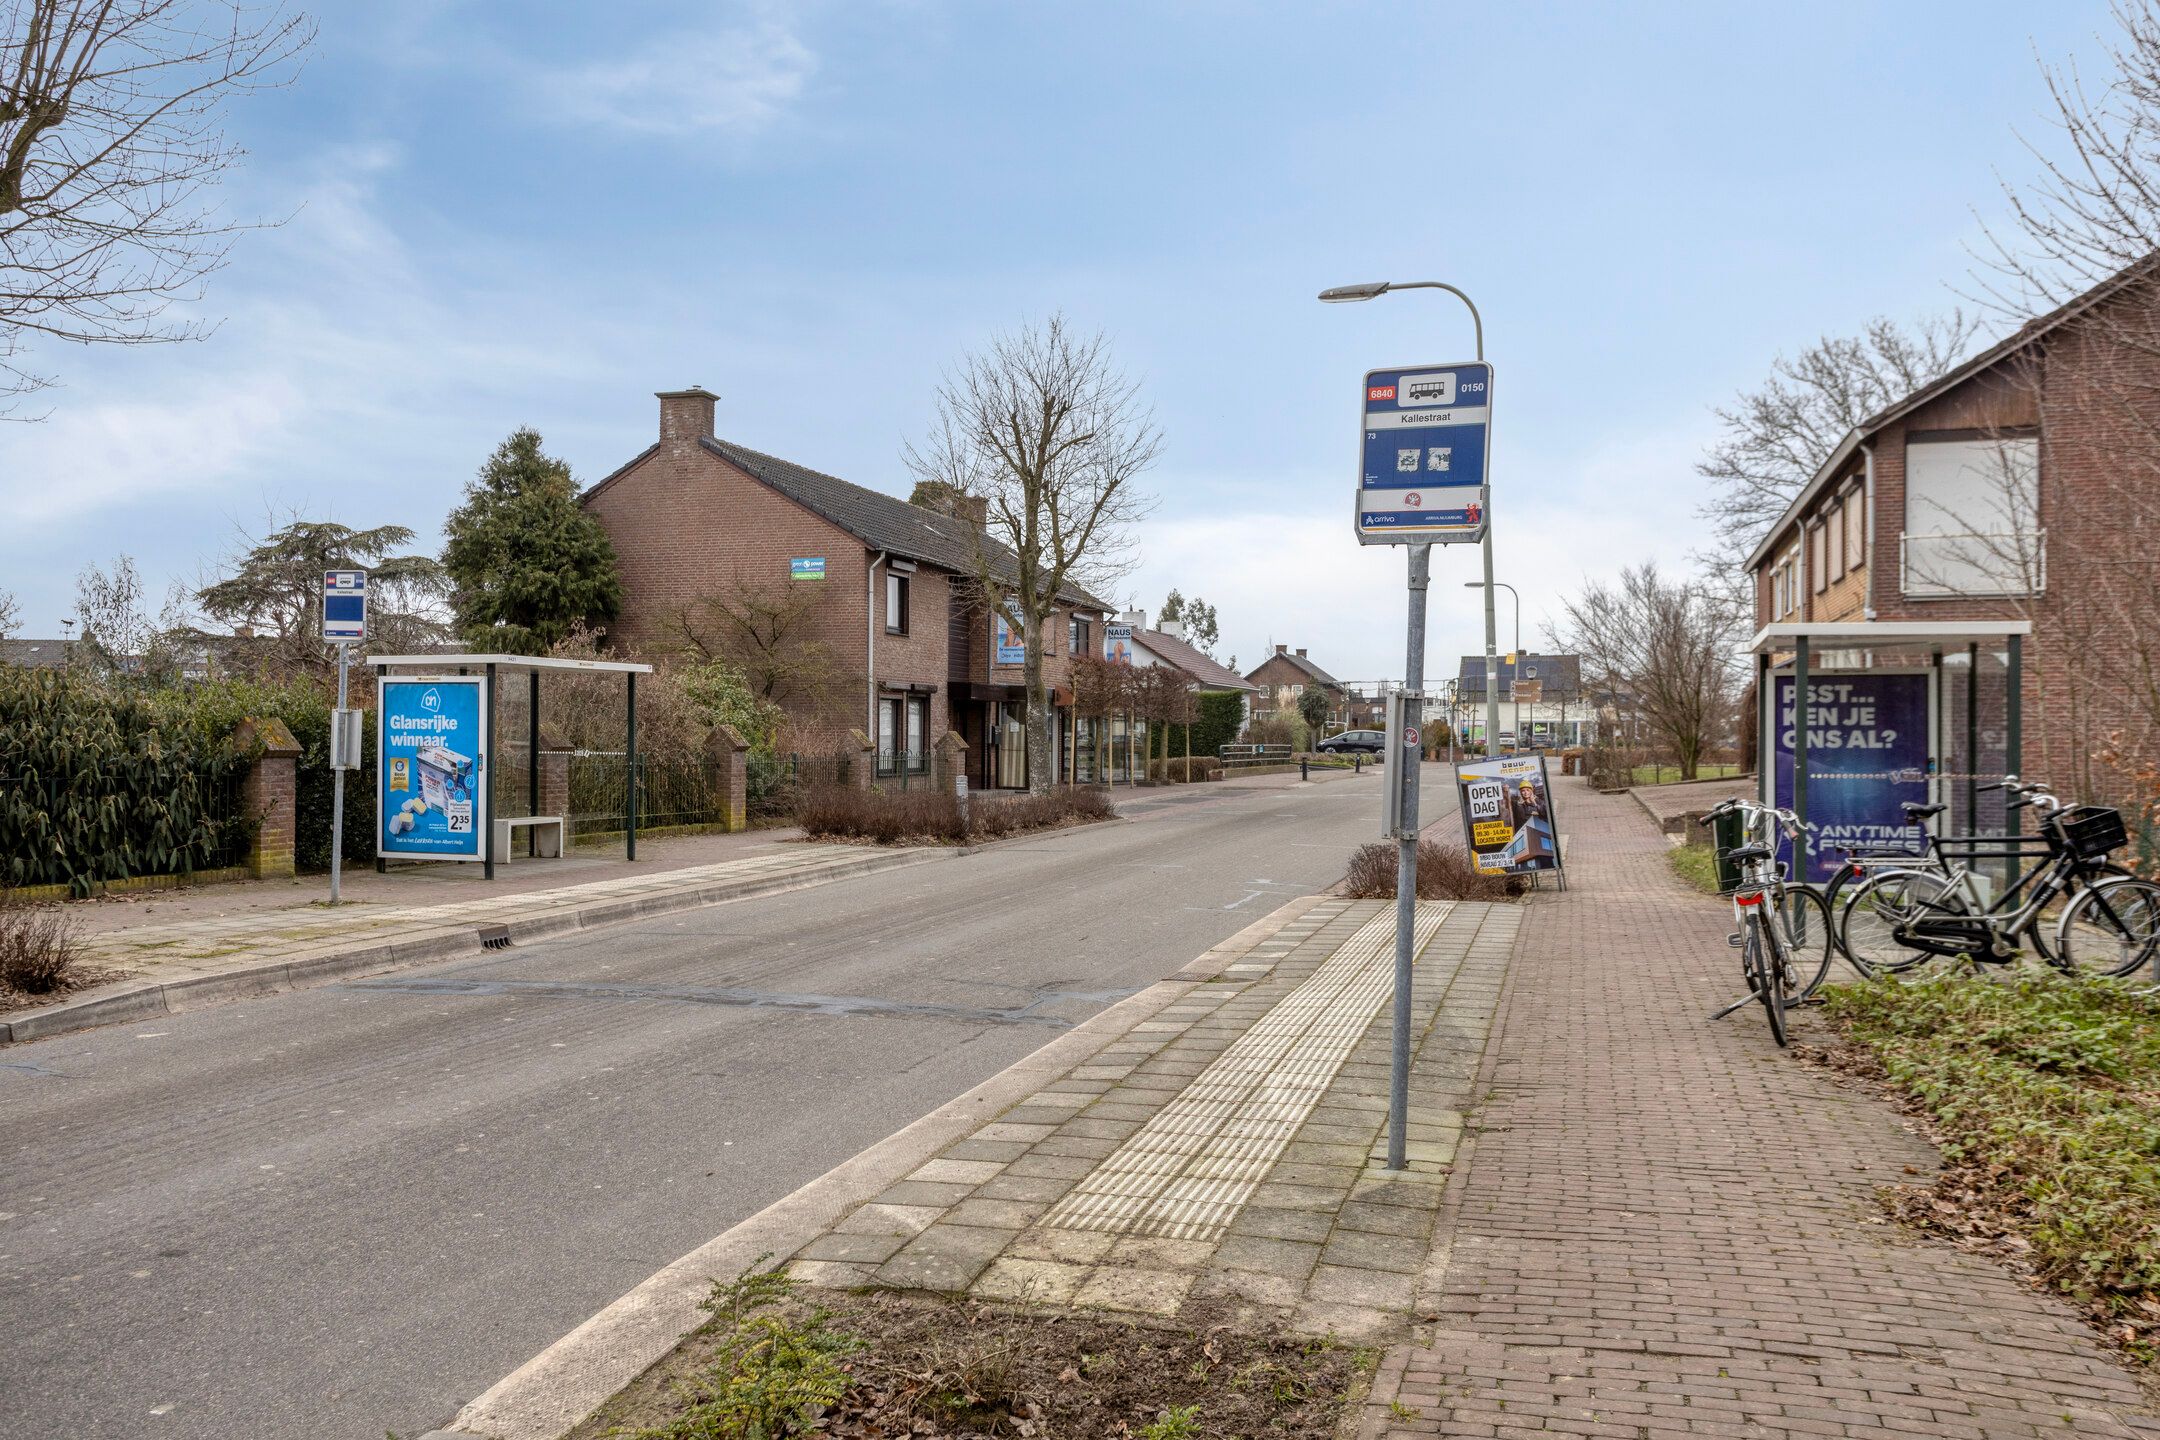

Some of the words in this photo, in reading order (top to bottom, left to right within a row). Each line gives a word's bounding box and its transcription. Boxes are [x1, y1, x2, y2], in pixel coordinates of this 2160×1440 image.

[1371, 390, 1392, 398] 6840
[1462, 383, 1484, 392] 0150
[1402, 412, 1451, 423] Kallestraat
[1783, 685, 1874, 703] PSST...
[390, 714, 458, 732] Glansrijke
[1783, 708, 1838, 726] KEN
[1842, 708, 1876, 726] JE
[390, 732, 448, 746] winnaar.
[1782, 730, 1842, 748] ONS
[1846, 730, 1898, 748] AL?
[1500, 765, 1536, 774] mensen
[1472, 786, 1500, 800] OPEN
[1474, 801, 1496, 814] DAG
[1820, 826, 1920, 838] ANYTIME
